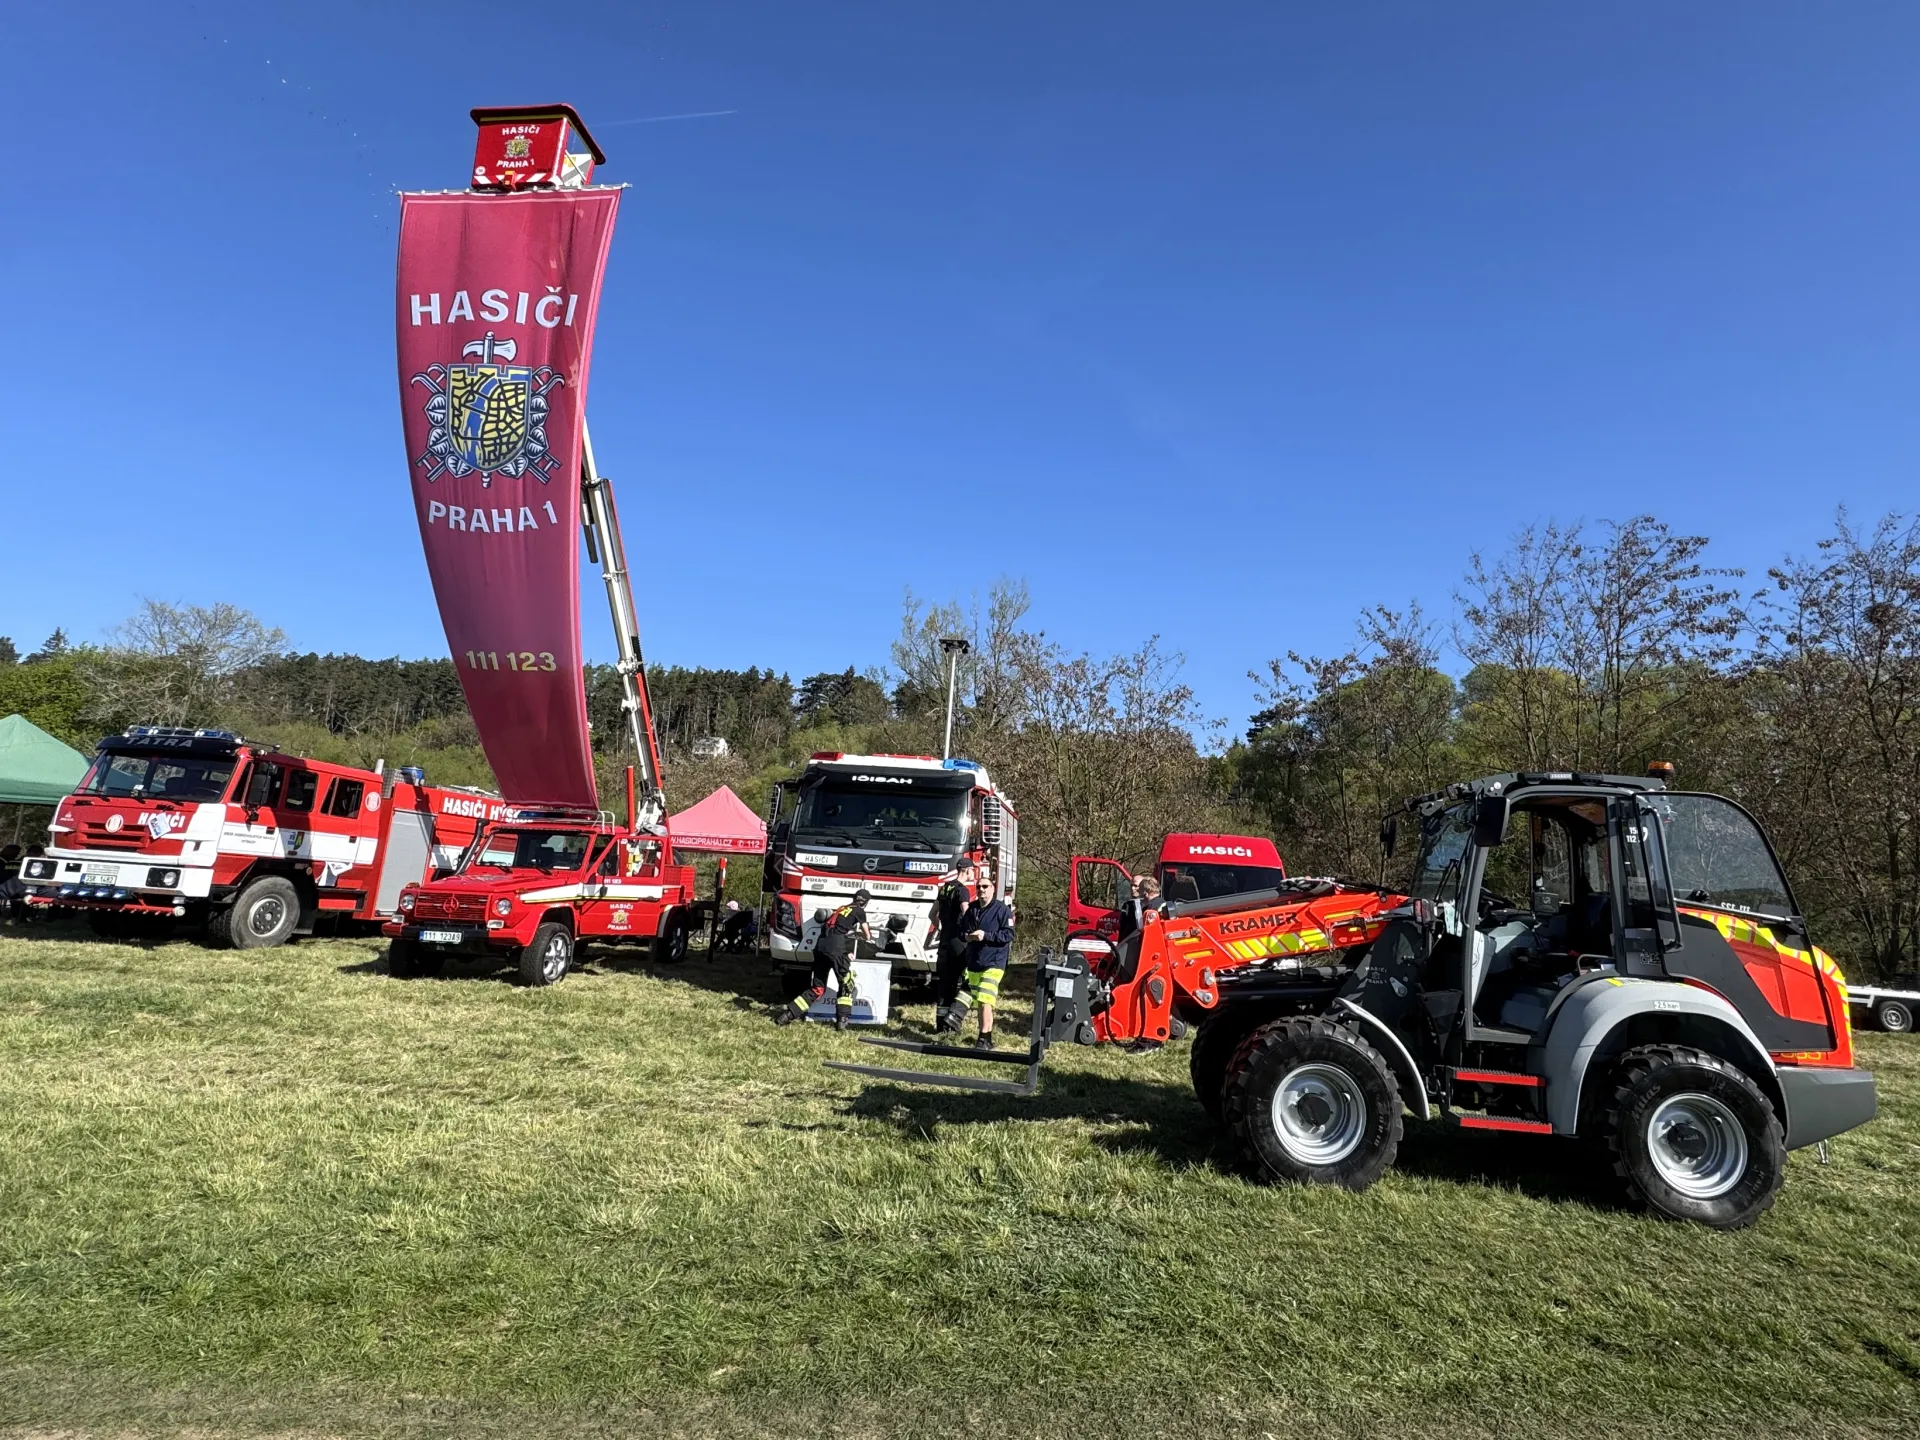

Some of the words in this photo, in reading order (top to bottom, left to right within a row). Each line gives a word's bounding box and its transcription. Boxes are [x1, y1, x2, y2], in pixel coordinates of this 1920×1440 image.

[502, 125, 540, 135] HASIČI
[496, 160, 529, 168] PRAHA
[410, 286, 578, 328] HASIČI
[428, 500, 539, 533] PRAHA
[542, 500, 558, 524] 1
[465, 650, 499, 671] 111
[506, 652, 557, 671] 123
[126, 737, 193, 747] TATRA
[442, 797, 487, 819] HASIČI
[1626, 835, 1637, 843] 112
[1189, 846, 1252, 857] HASIČI
[1219, 911, 1298, 935] KRAMER
[424, 931, 436, 939] 111
[440, 933, 461, 942] 123A9
